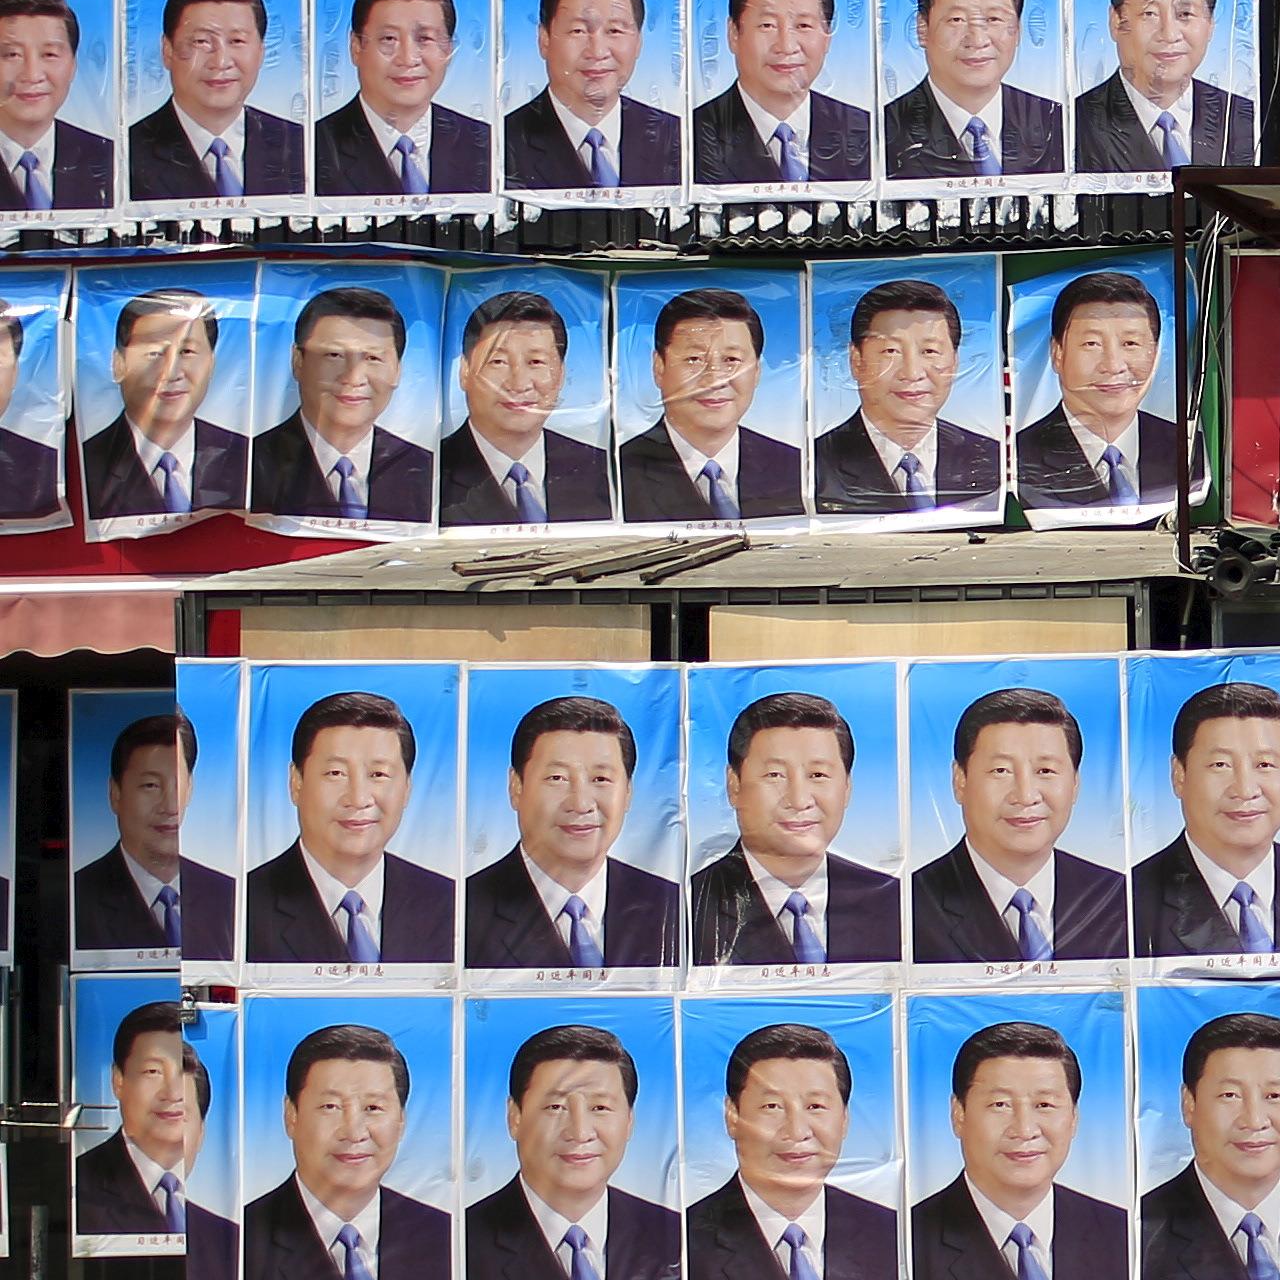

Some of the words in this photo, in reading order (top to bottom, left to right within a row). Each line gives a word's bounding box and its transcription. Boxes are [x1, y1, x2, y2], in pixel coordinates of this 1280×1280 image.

[751, 182, 814, 195] 习近平同志
[945, 177, 1008, 189] 习近平同志
[188, 197, 249, 210] 习近平同志
[684, 521, 747, 532] 习近平同志
[1205, 954, 1280, 969] 习近平同志
[315, 964, 385, 977] 习近平同志
[535, 968, 610, 982] 习近平同志
[760, 964, 833, 978] 习近平同志
[137, 1236, 185, 1246] 习近平同
